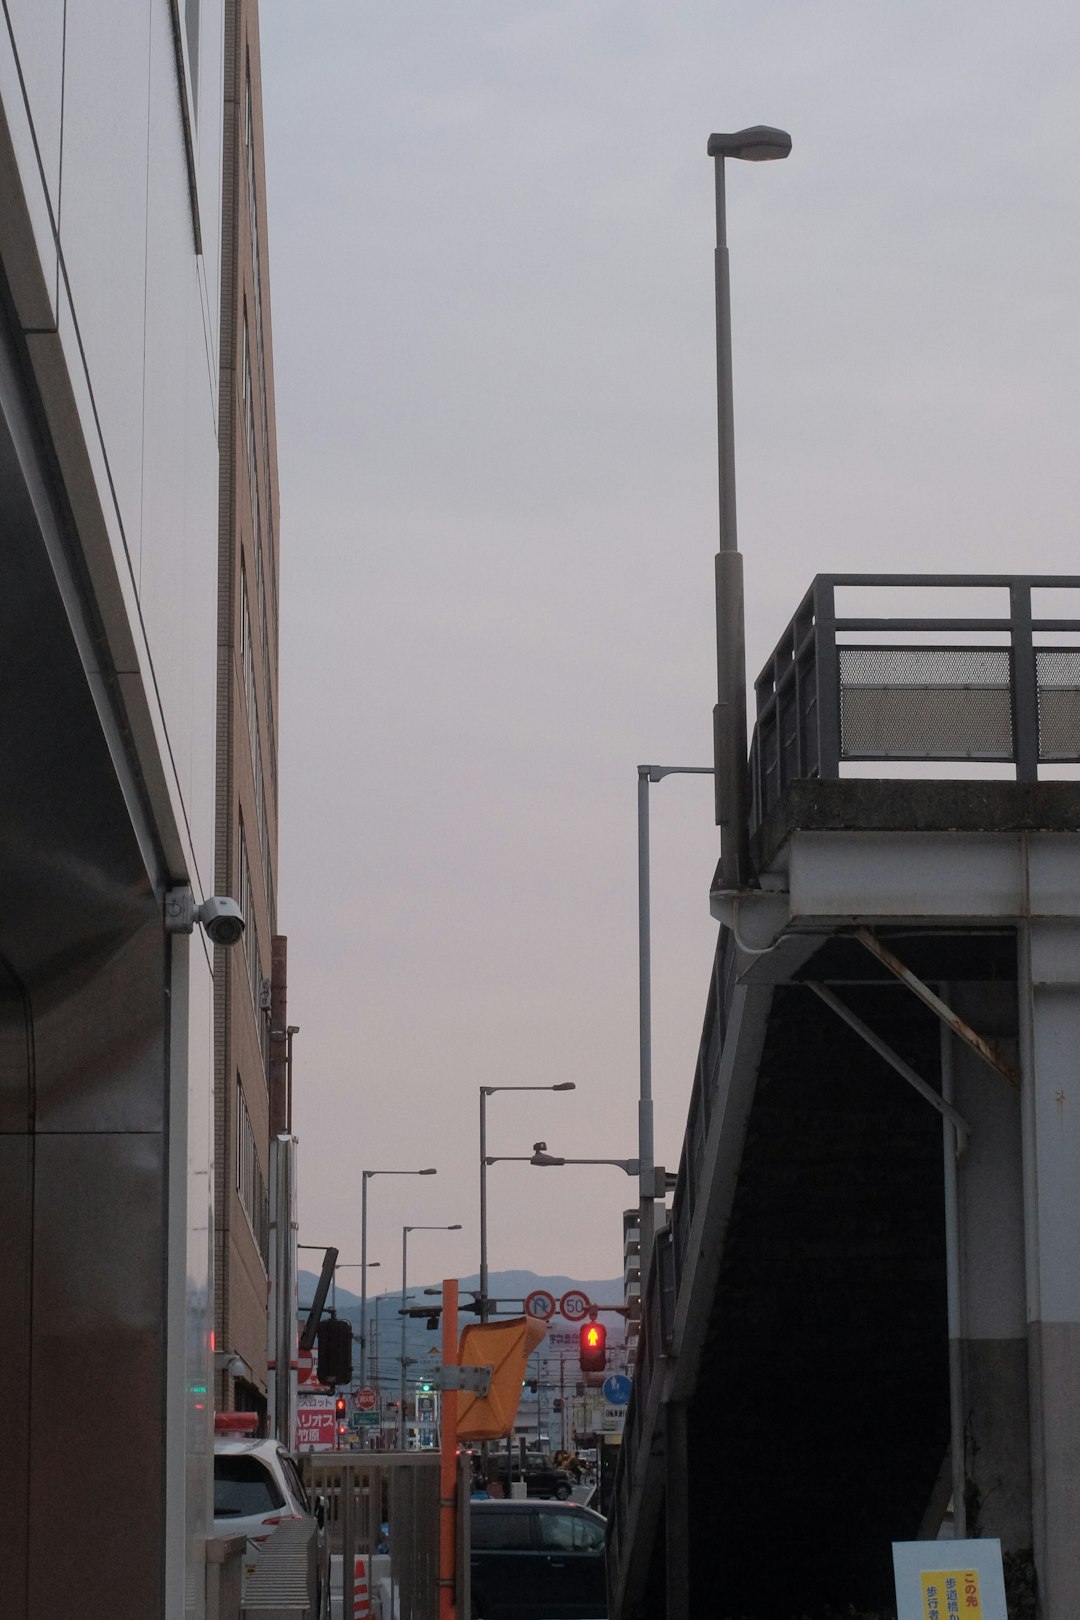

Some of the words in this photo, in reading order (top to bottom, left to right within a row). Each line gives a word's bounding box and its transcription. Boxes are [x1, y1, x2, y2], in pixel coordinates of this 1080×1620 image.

[566, 1299, 584, 1313] 50
[964, 1573, 979, 1608] この先
